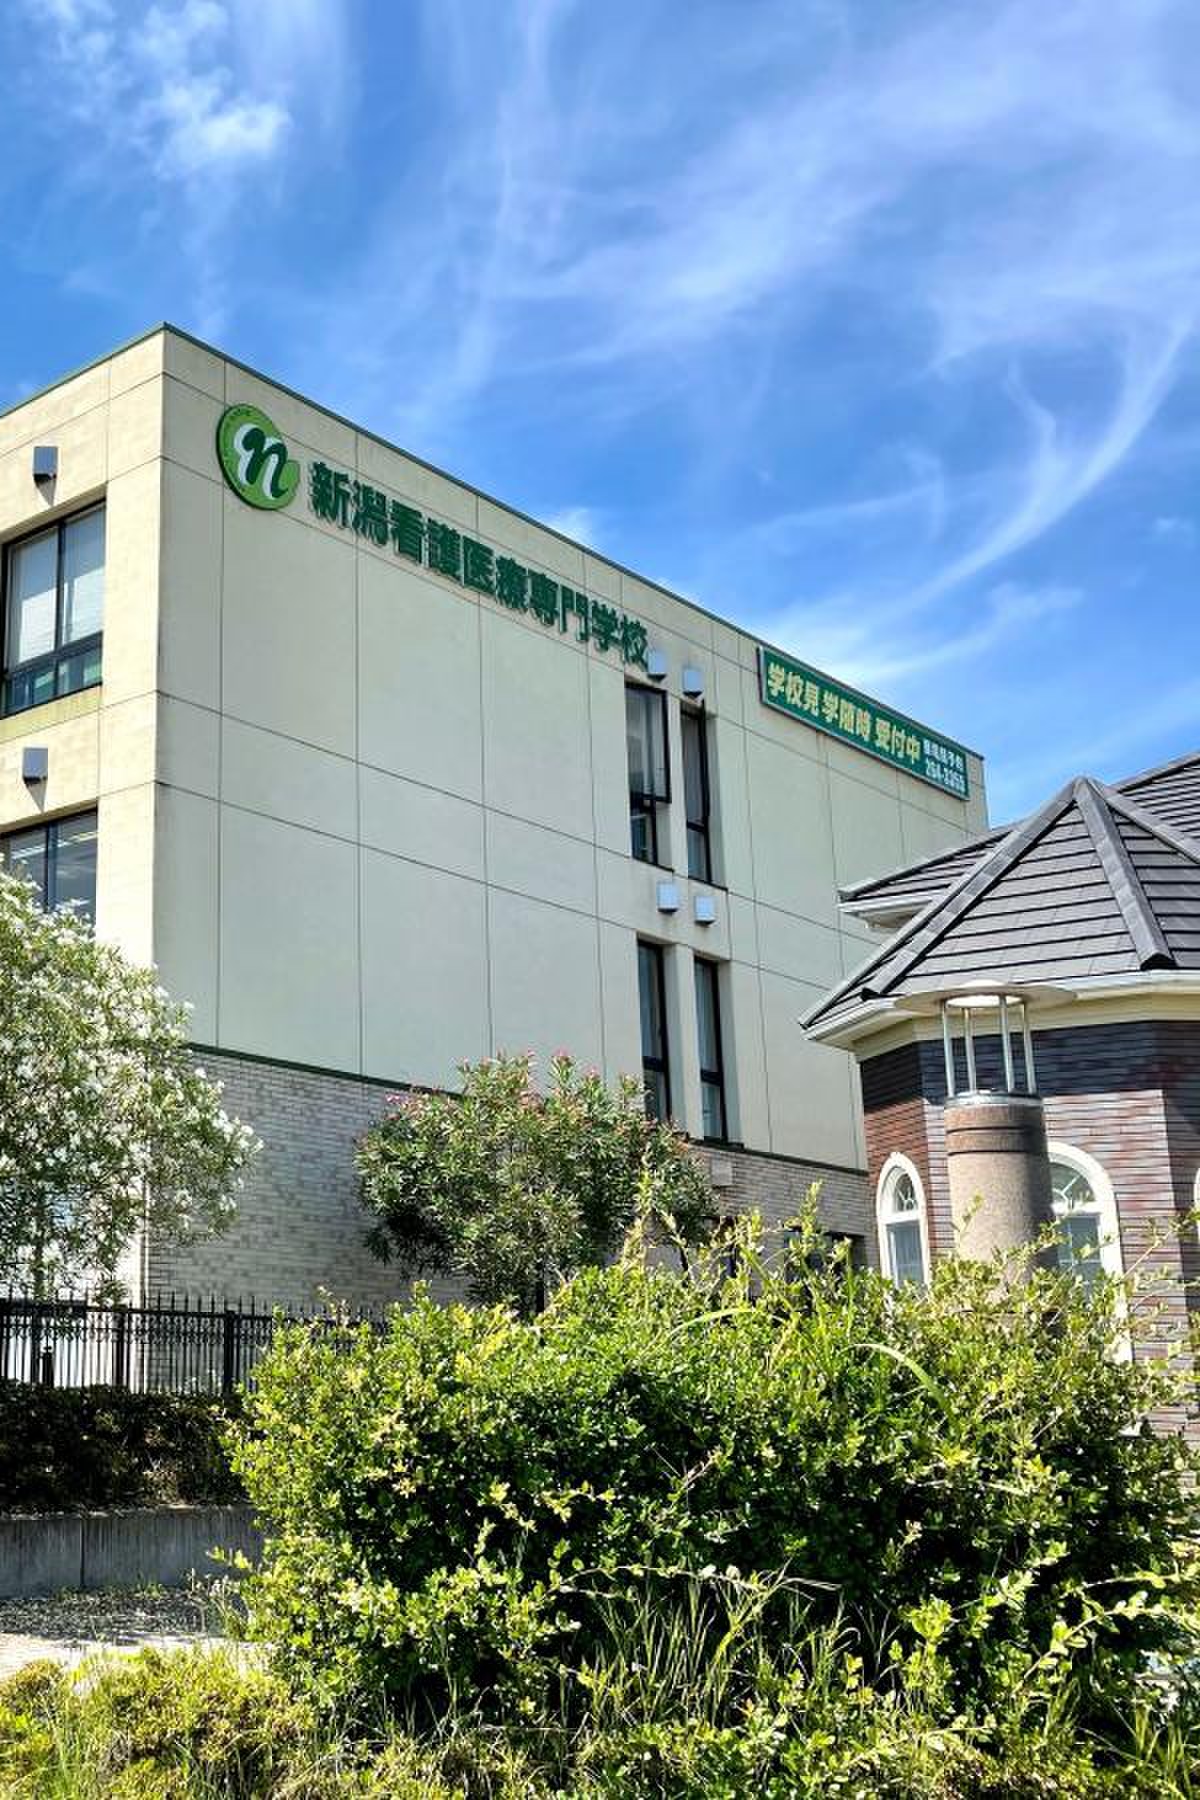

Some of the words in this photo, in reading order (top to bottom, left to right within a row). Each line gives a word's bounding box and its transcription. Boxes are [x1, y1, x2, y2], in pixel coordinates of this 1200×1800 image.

[307, 460, 649, 672] 新潟看護医療専門学校
